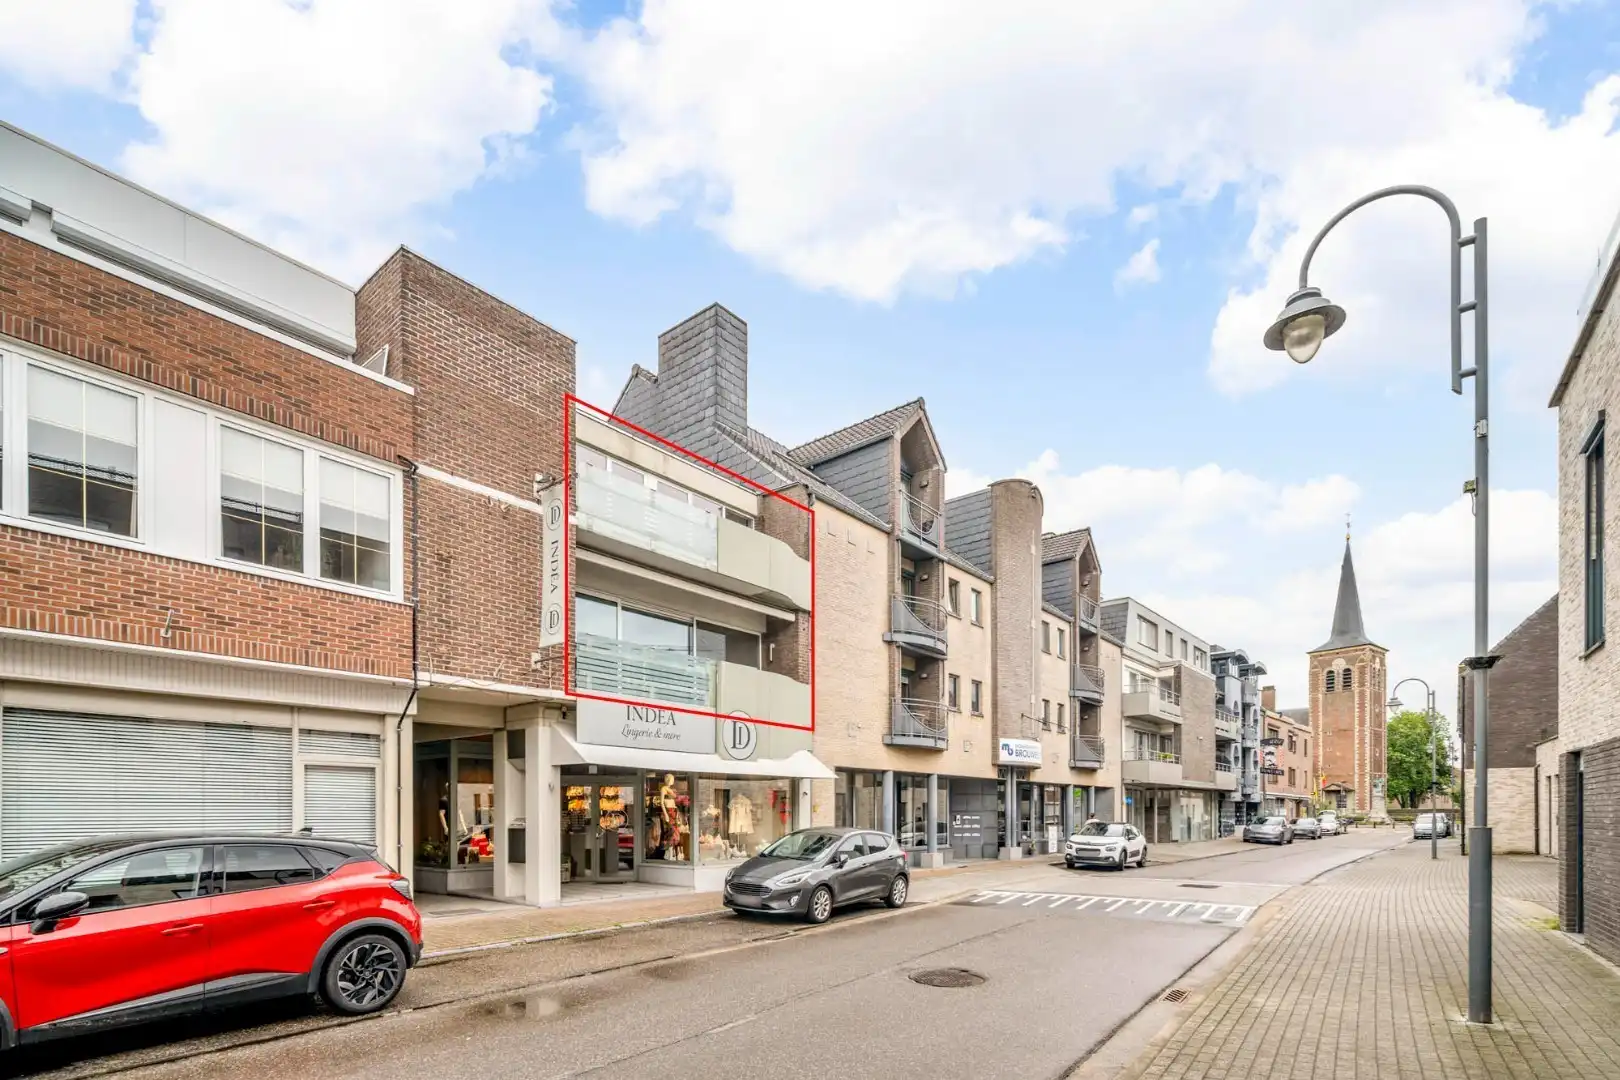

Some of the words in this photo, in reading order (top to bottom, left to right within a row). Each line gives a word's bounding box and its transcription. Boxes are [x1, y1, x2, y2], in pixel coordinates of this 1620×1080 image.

[550, 539, 559, 594] INDEA
[626, 705, 676, 725] INDEA
[621, 723, 653, 740] Lingerie
[654, 728, 662, 739] &
